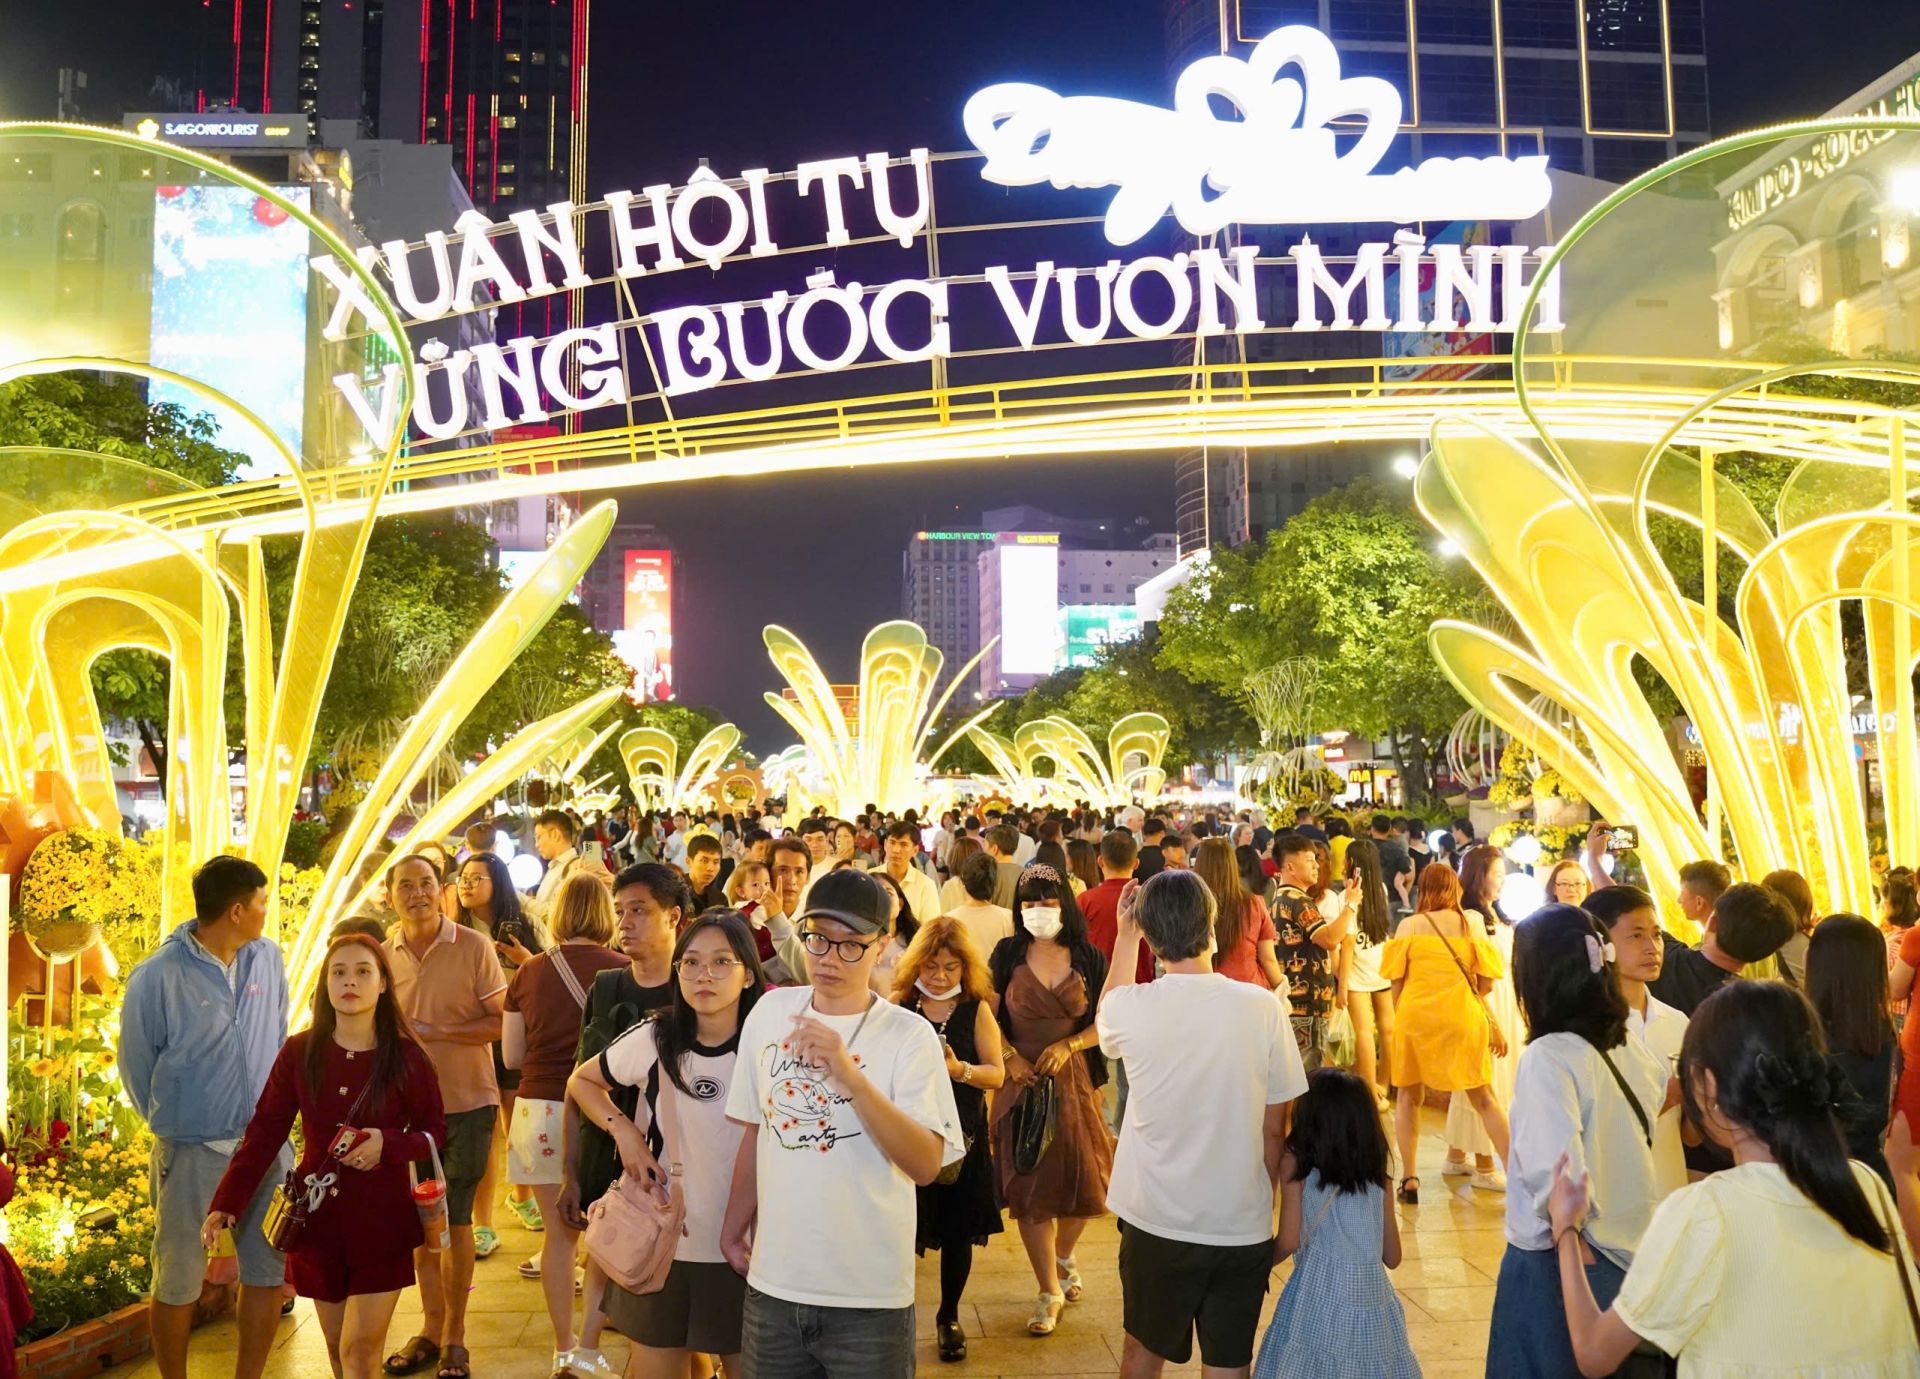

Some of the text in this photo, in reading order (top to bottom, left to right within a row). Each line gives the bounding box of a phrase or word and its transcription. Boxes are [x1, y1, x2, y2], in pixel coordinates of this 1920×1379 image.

[165, 123, 259, 135] SAIGONTOURIST
[310, 148, 930, 341] XUÂN HỘI TỤ
[650, 270, 950, 397] BƯỚC
[985, 245, 1265, 350] VƯƠN
[1288, 229, 1566, 332] MÌNH
[927, 531, 960, 540] HARBOUR
[962, 531, 980, 540] VIEW
